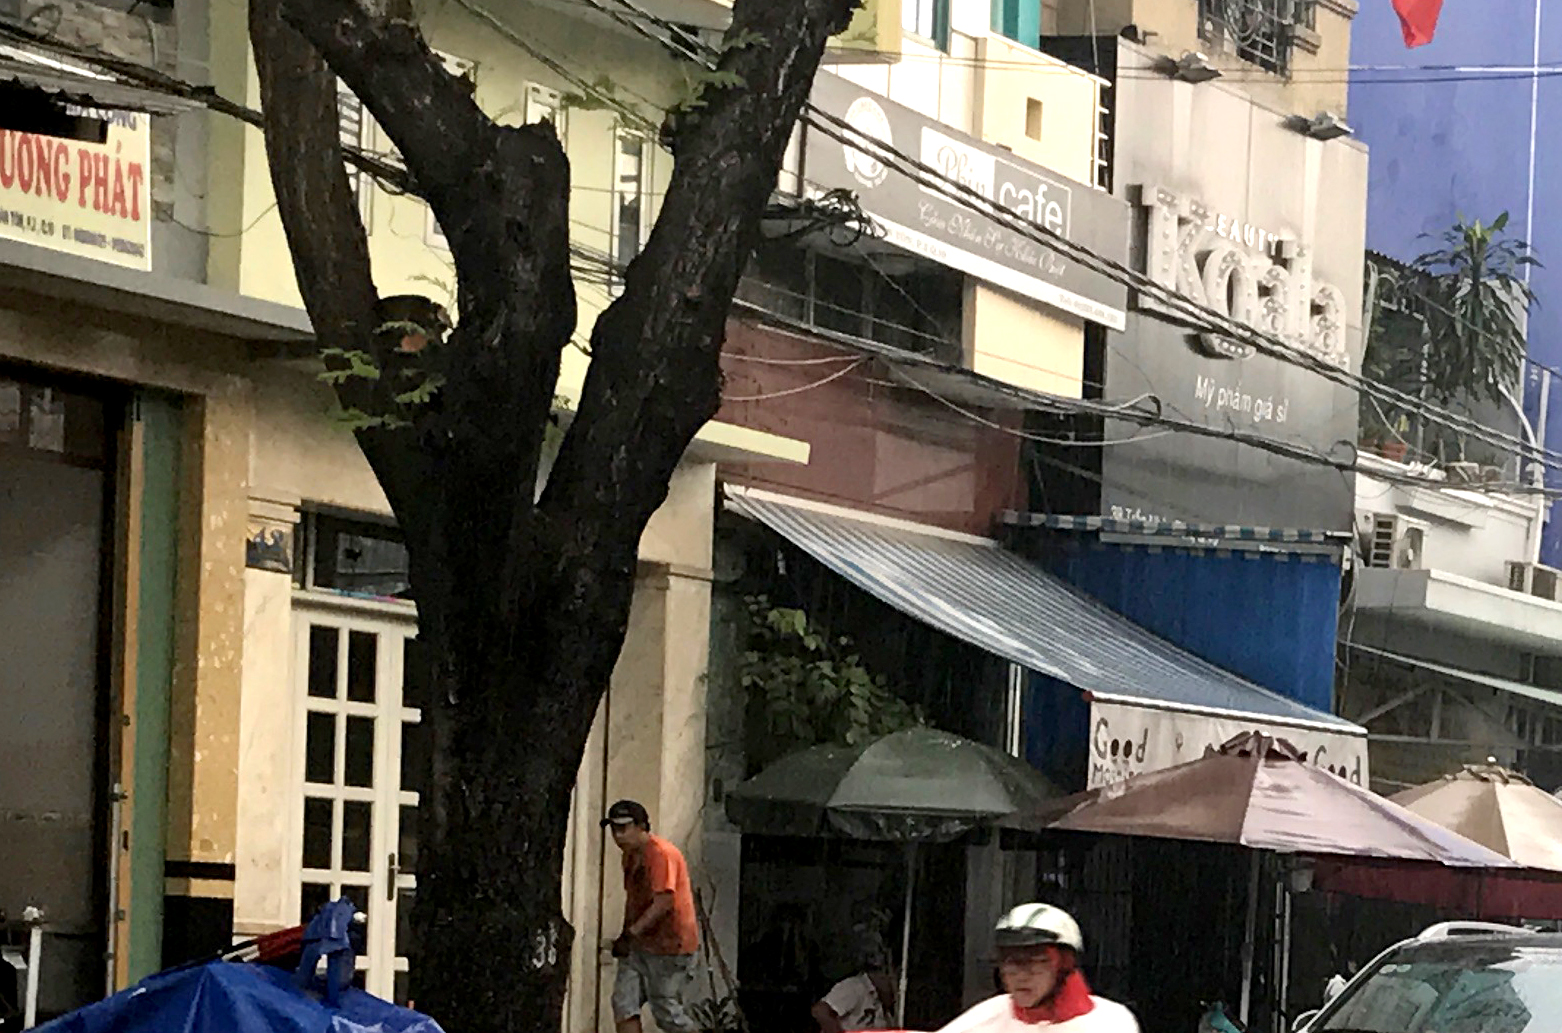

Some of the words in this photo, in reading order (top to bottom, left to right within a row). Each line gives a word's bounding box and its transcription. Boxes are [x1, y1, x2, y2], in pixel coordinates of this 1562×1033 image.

[77, 139, 144, 222] PHÁT
[999, 182, 1063, 237] cafe
[1205, 213, 1280, 256] EAUTY
[1138, 186, 1350, 367] Koala
[1094, 717, 1149, 764] Good
